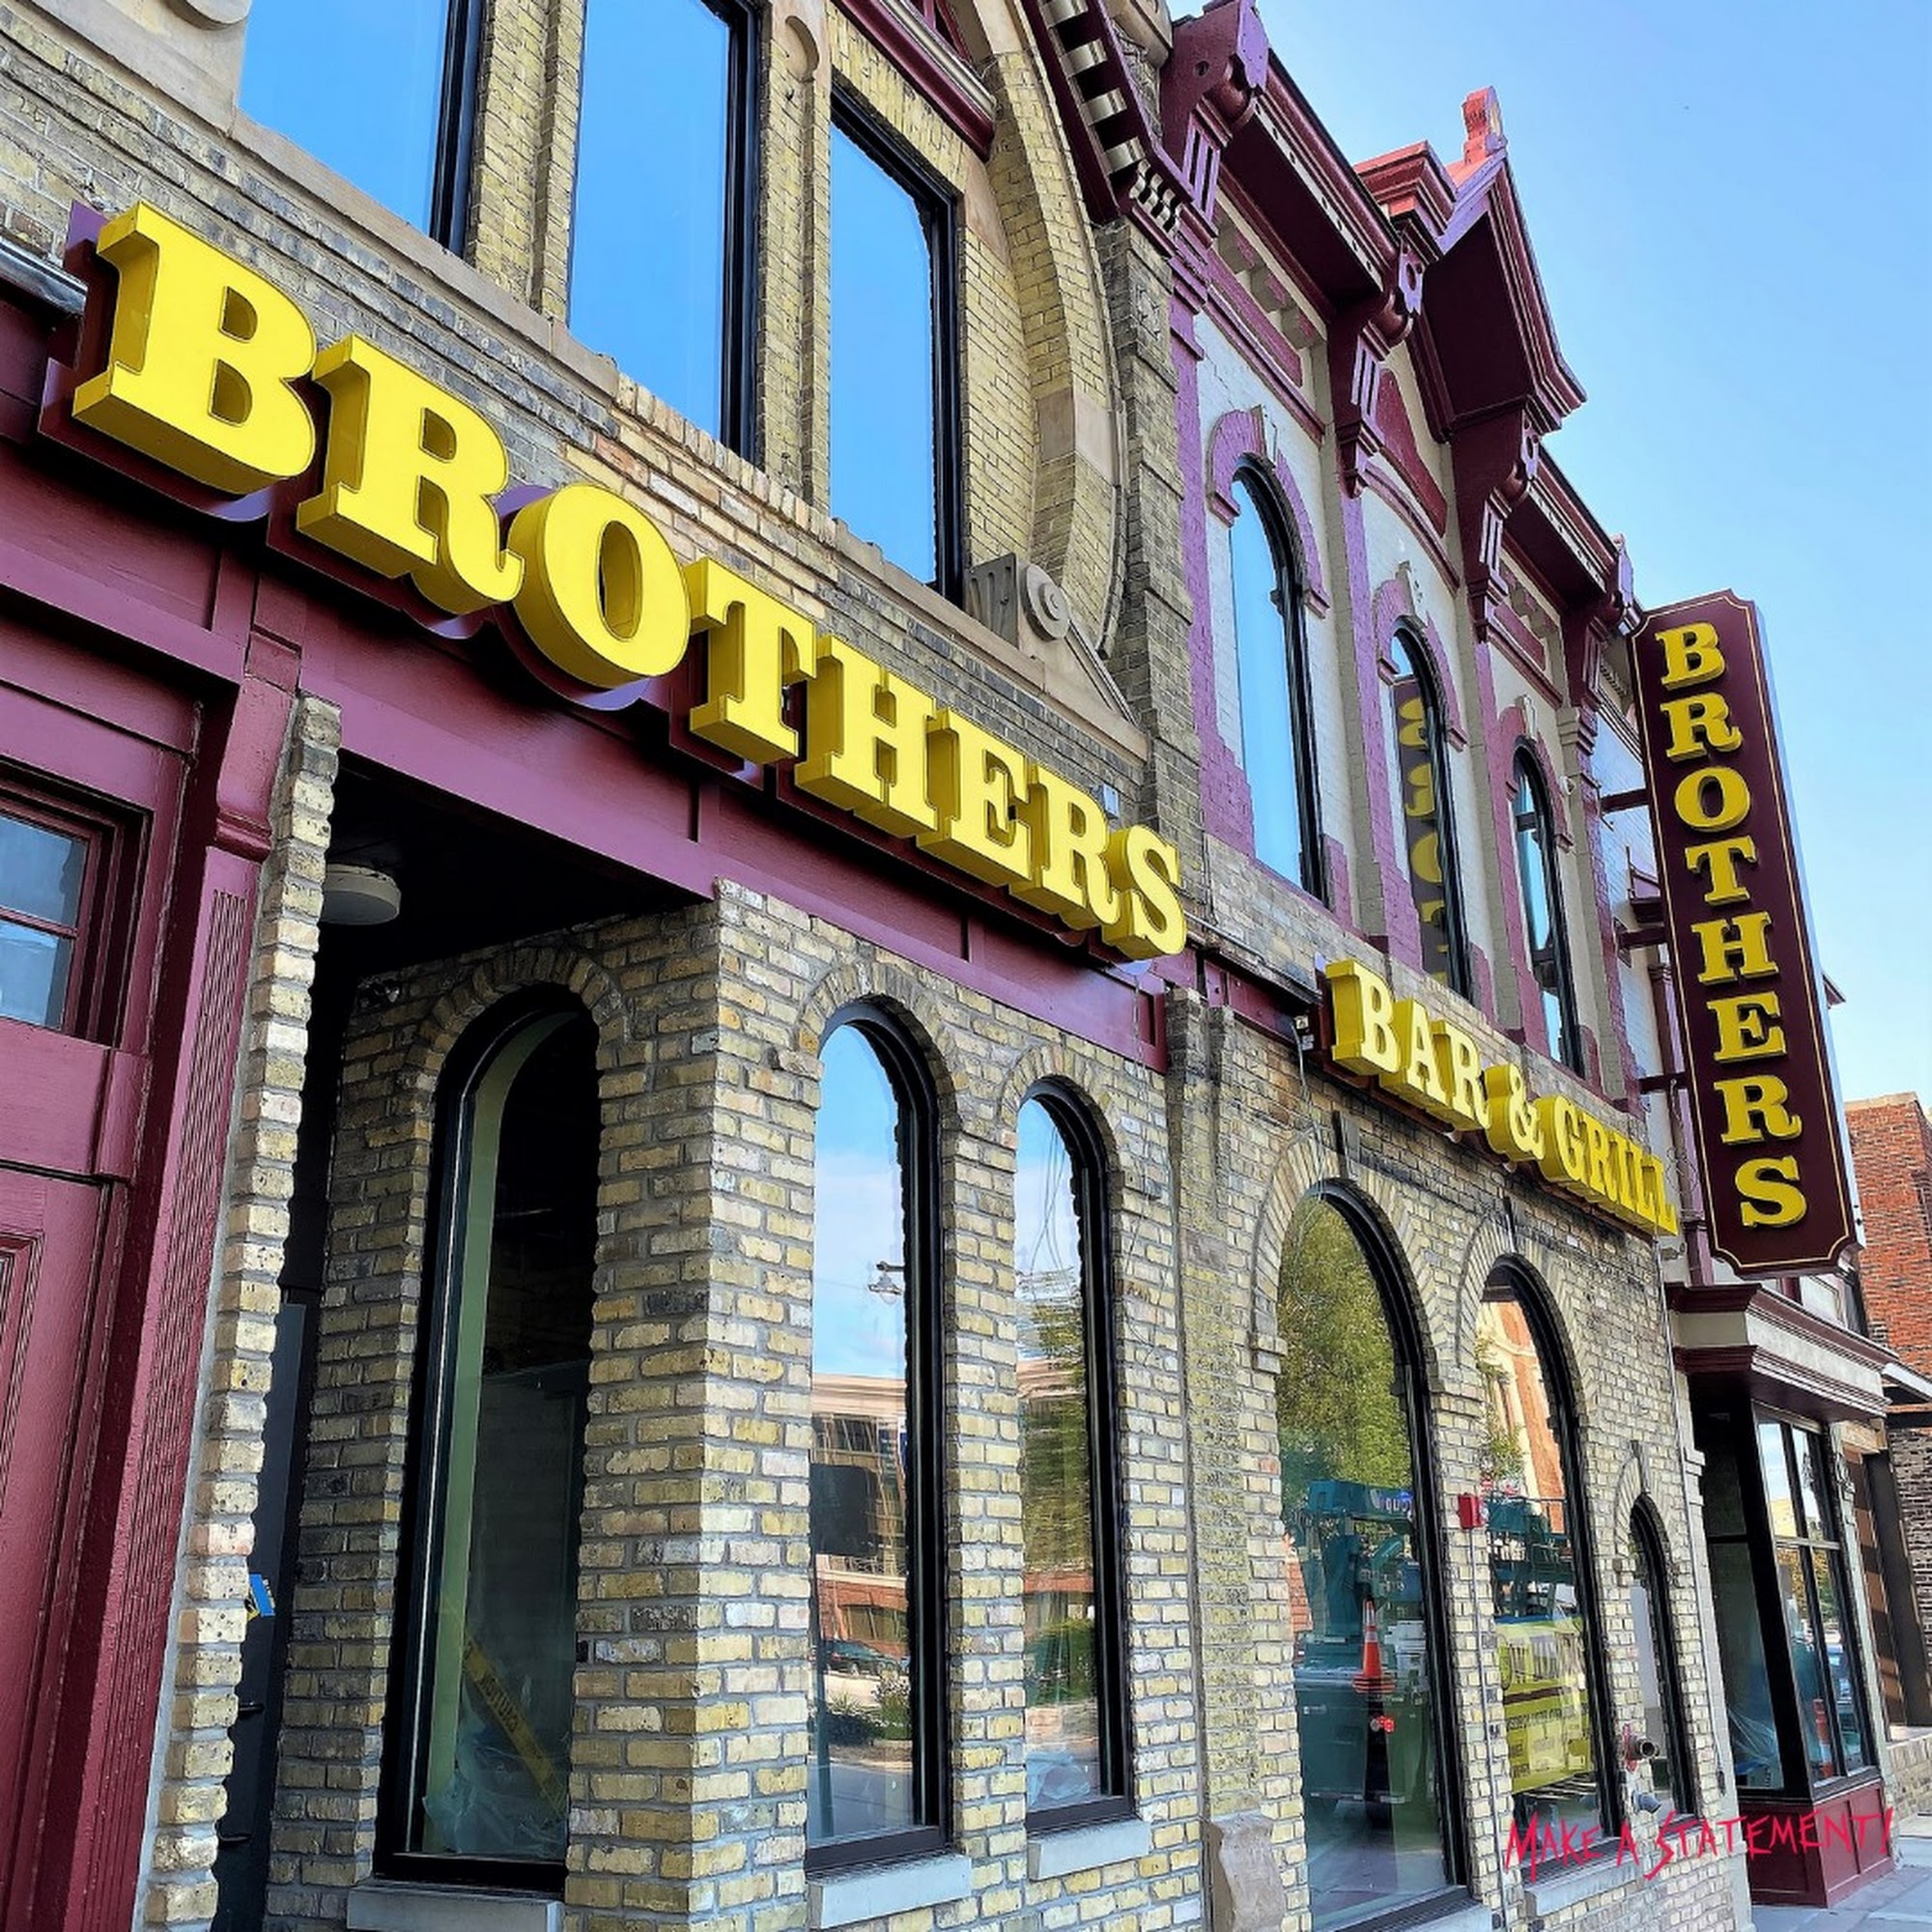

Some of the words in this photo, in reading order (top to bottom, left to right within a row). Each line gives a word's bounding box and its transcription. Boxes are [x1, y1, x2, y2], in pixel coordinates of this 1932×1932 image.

[73, 201, 1186, 959] BROTHERS
[1326, 959, 1491, 1130] BAR
[1485, 1063, 1544, 1161] &
[1537, 1094, 1678, 1236] GRILL
[1655, 622, 1806, 1230] BROTHERS
